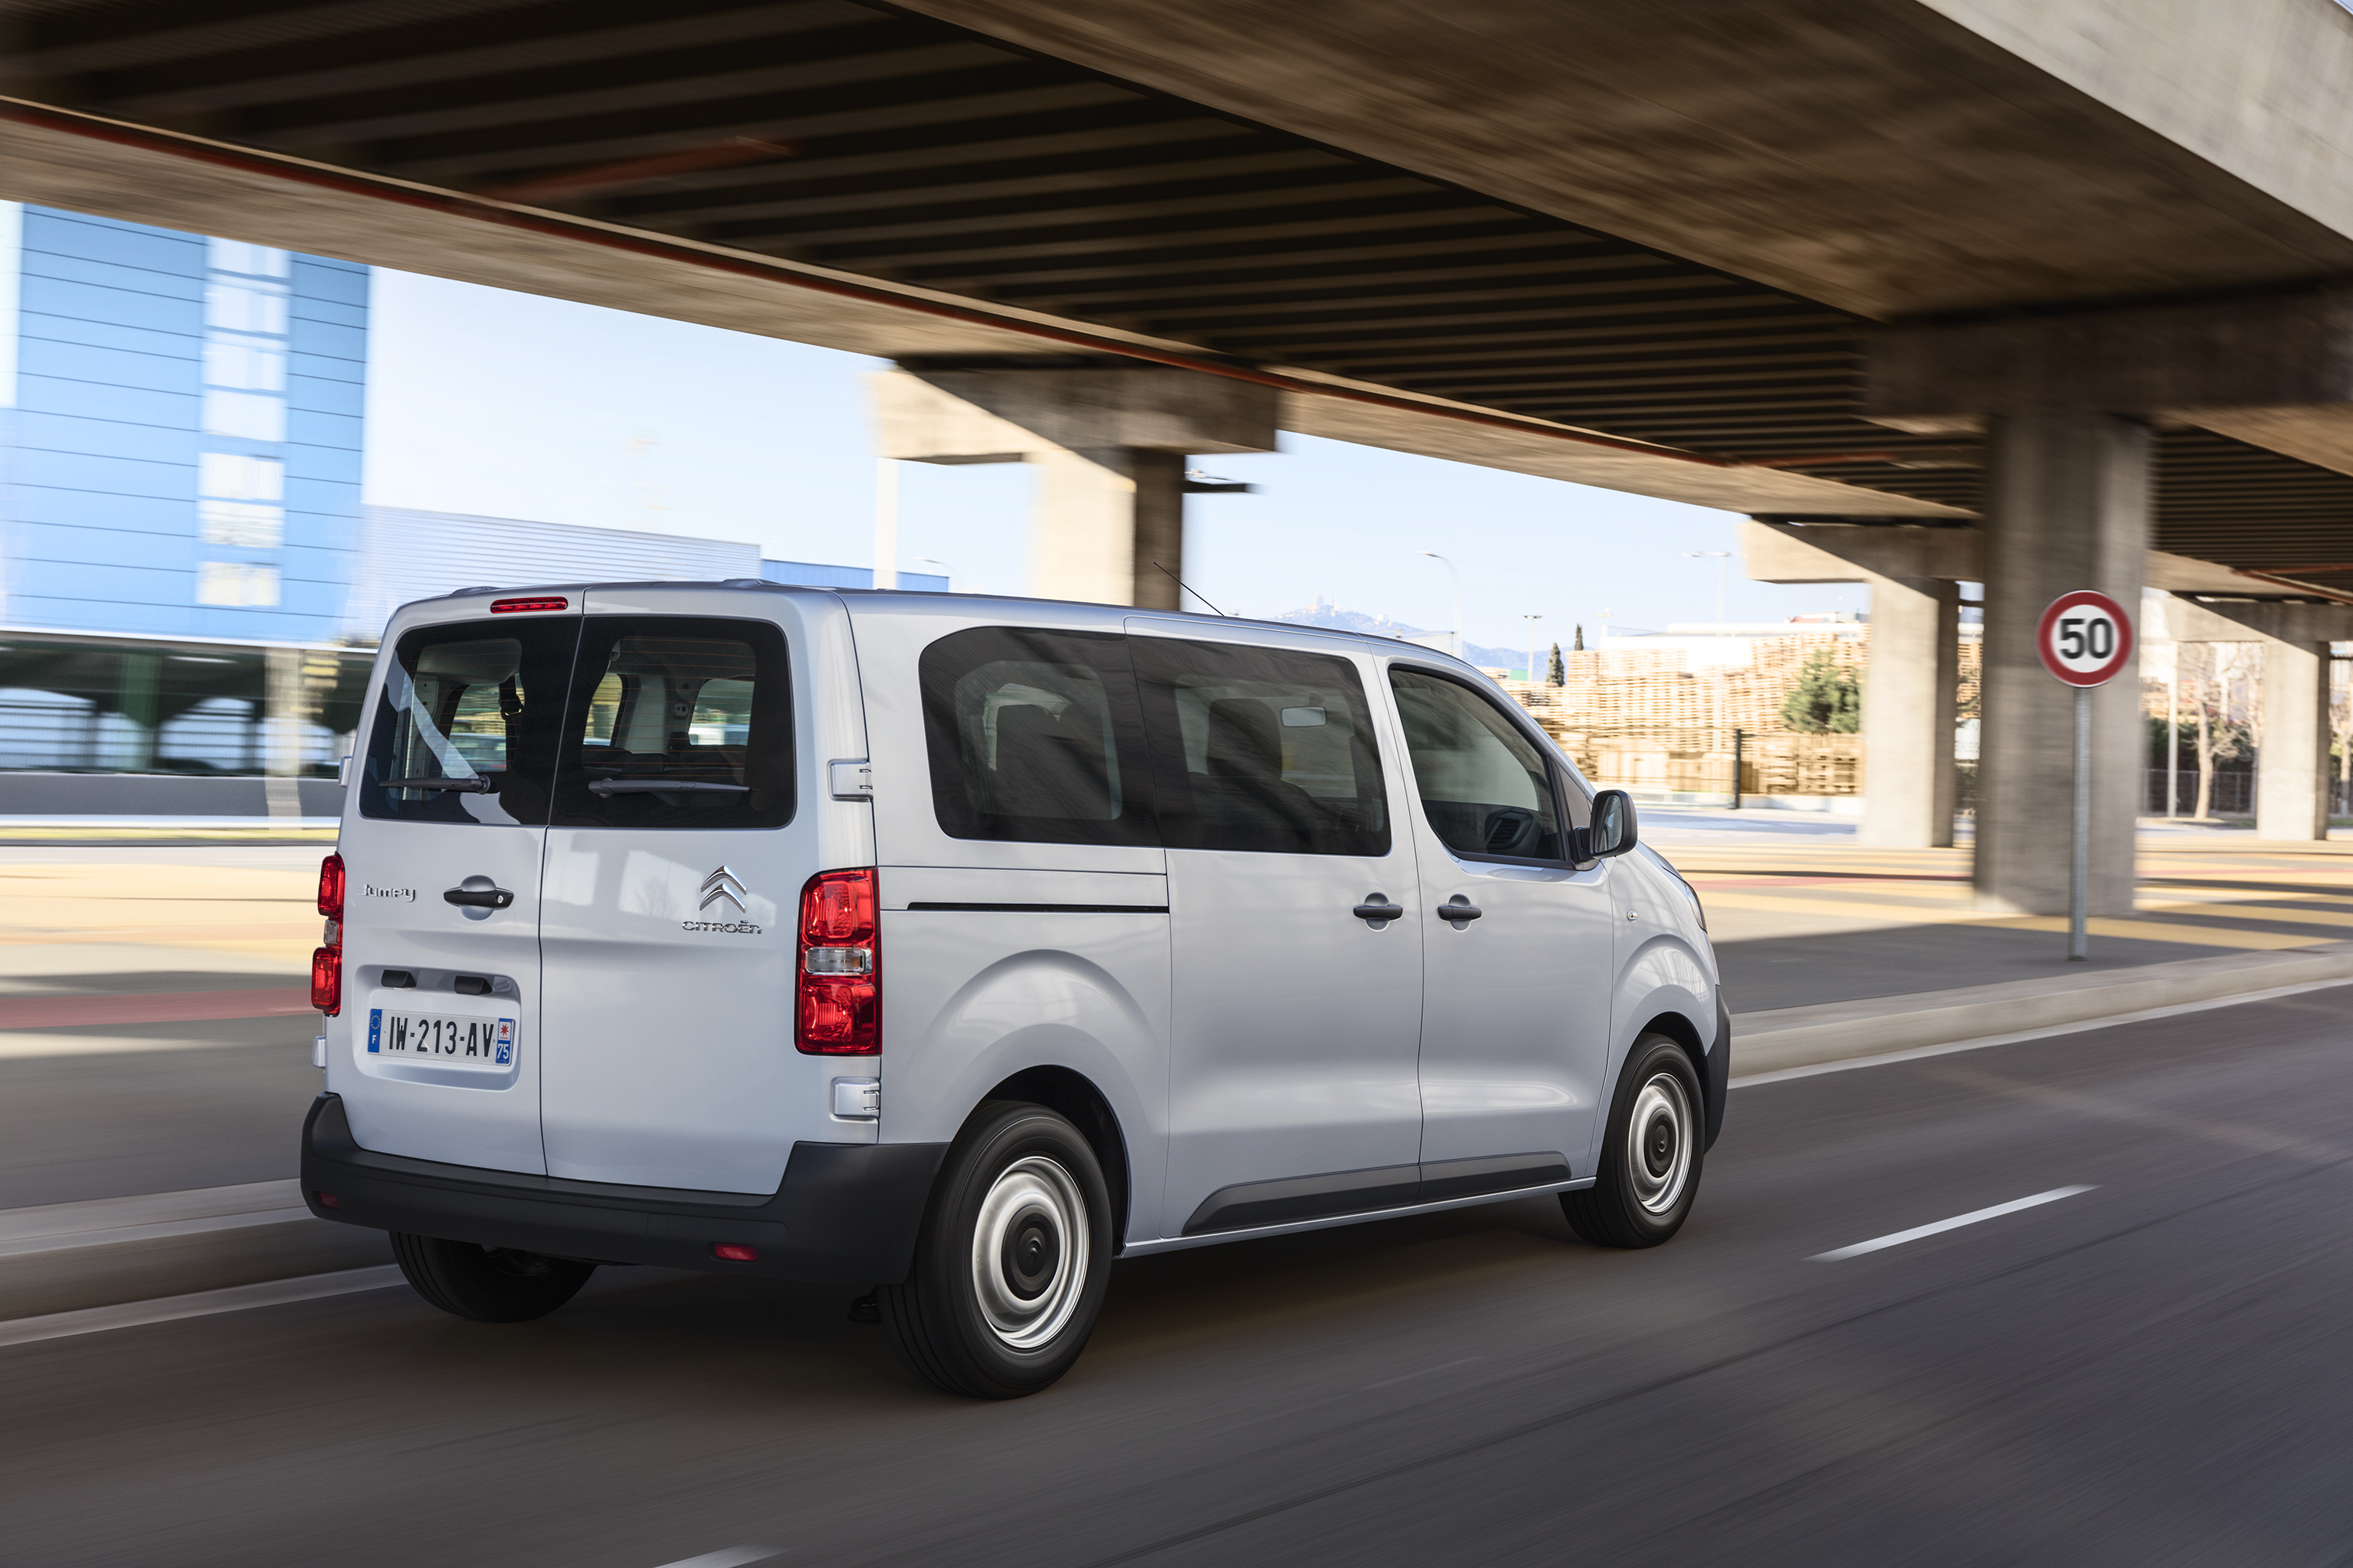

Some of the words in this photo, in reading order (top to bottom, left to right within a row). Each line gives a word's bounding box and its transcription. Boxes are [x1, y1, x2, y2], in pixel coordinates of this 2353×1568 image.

[2059, 617, 2113, 660] 50
[372, 1035, 377, 1044] F
[388, 1016, 494, 1057] IW-213-AV
[497, 1043, 510, 1059] 75
